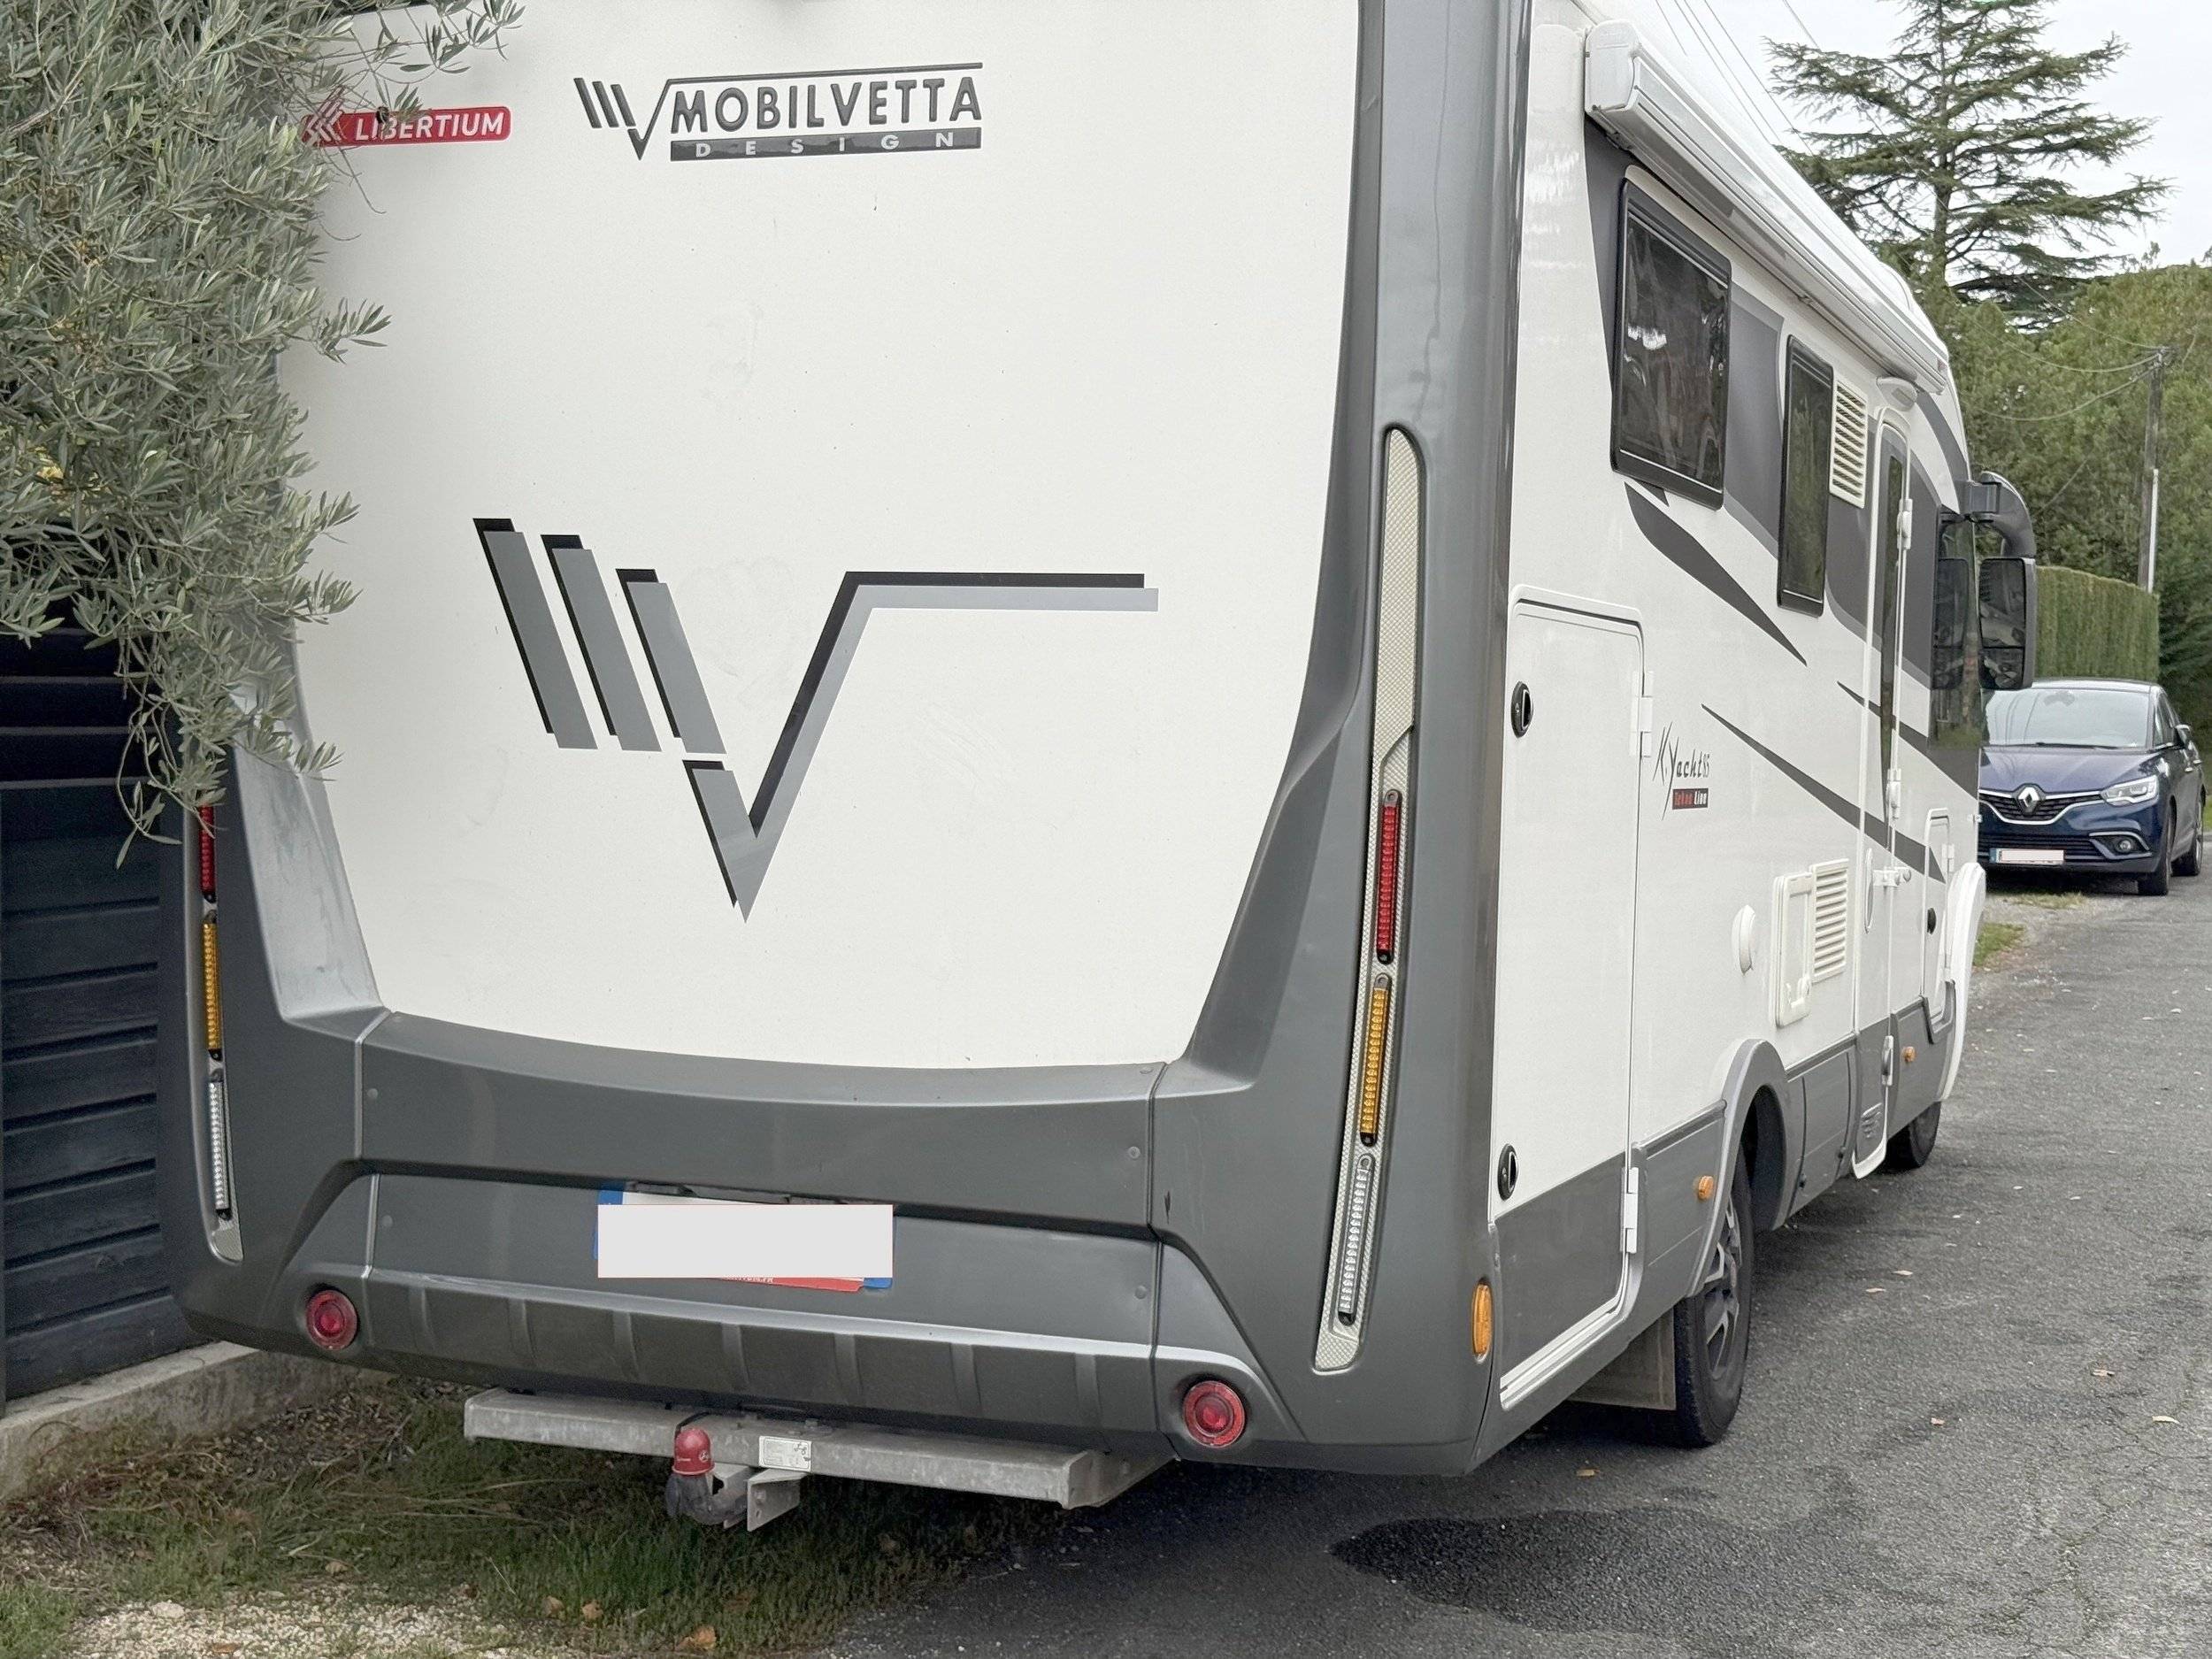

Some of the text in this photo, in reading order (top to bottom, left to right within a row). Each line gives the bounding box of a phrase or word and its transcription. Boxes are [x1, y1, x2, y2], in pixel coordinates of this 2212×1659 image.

[671, 76, 982, 134] MOBILVETTA
[356, 112, 504, 142] LIBERTIUM
[695, 132, 954, 158] DESIGN
